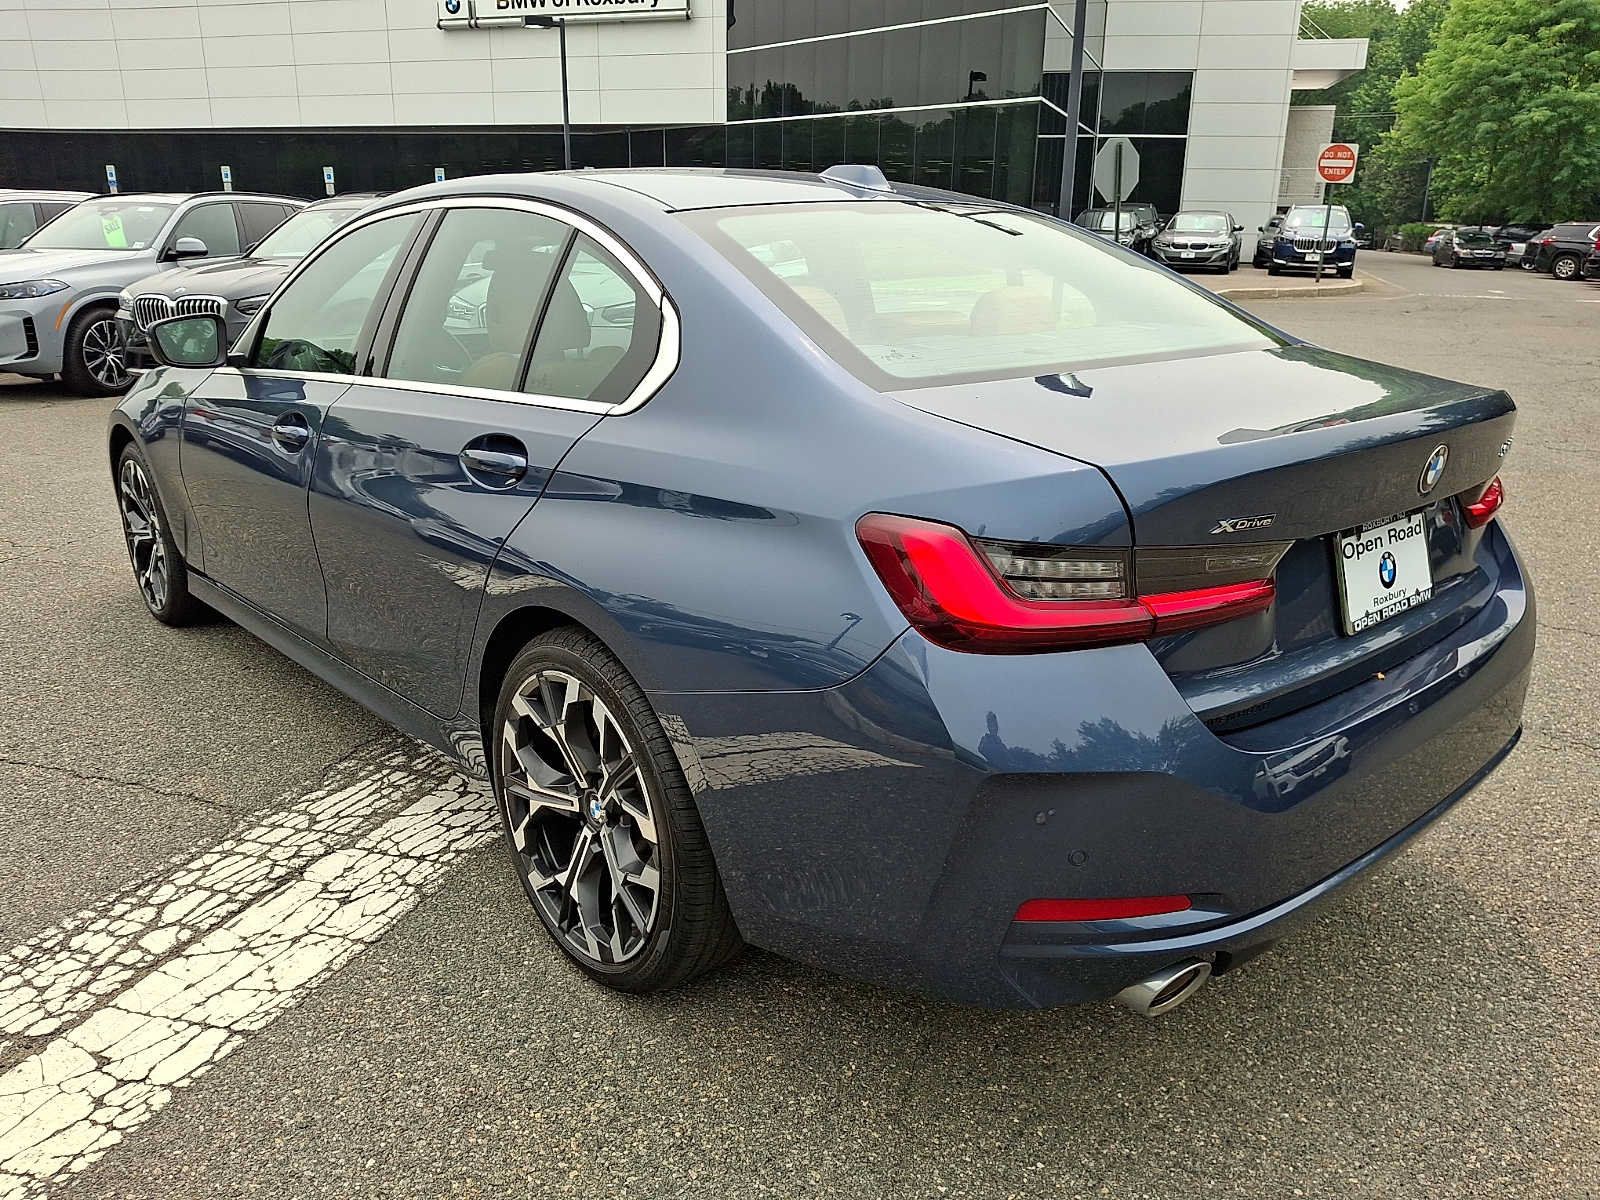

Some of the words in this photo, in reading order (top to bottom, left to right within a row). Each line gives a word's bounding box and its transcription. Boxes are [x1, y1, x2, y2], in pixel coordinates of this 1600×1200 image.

[1324, 167, 1346, 175] ENTER
[1342, 535, 1384, 560] Open
[1387, 520, 1422, 545] Road
[1353, 611, 1380, 632] OPEN
[1382, 600, 1408, 619] ROAD
[1410, 589, 1432, 606] BMW
[1373, 587, 1407, 607] Roxbury
